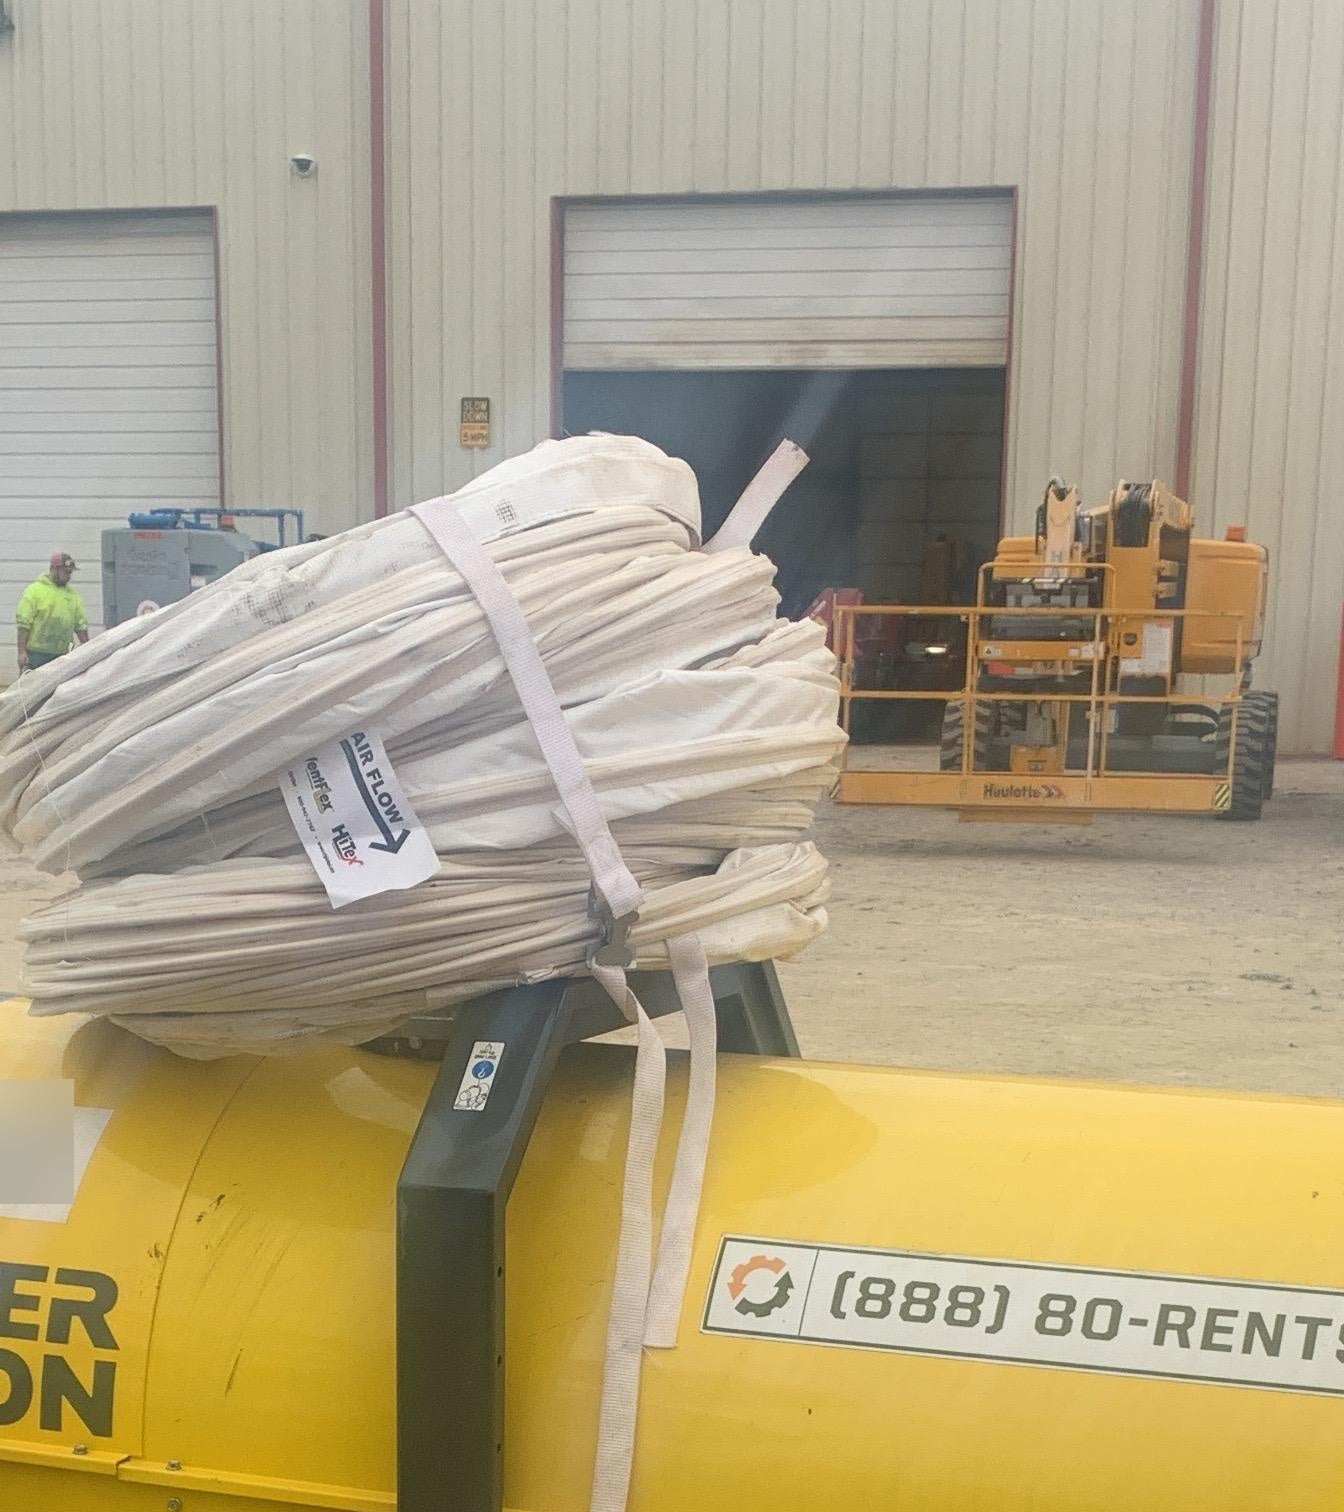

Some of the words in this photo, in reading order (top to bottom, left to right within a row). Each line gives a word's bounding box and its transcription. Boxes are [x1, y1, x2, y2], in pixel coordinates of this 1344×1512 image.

[463, 400, 487, 409] SLOW
[463, 410, 487, 421] DOWN
[351, 731, 374, 766] AIR
[366, 768, 405, 824] FLOW
[983, 783, 1041, 799] Haulotte
[830, 1270, 1010, 1335] (888)
